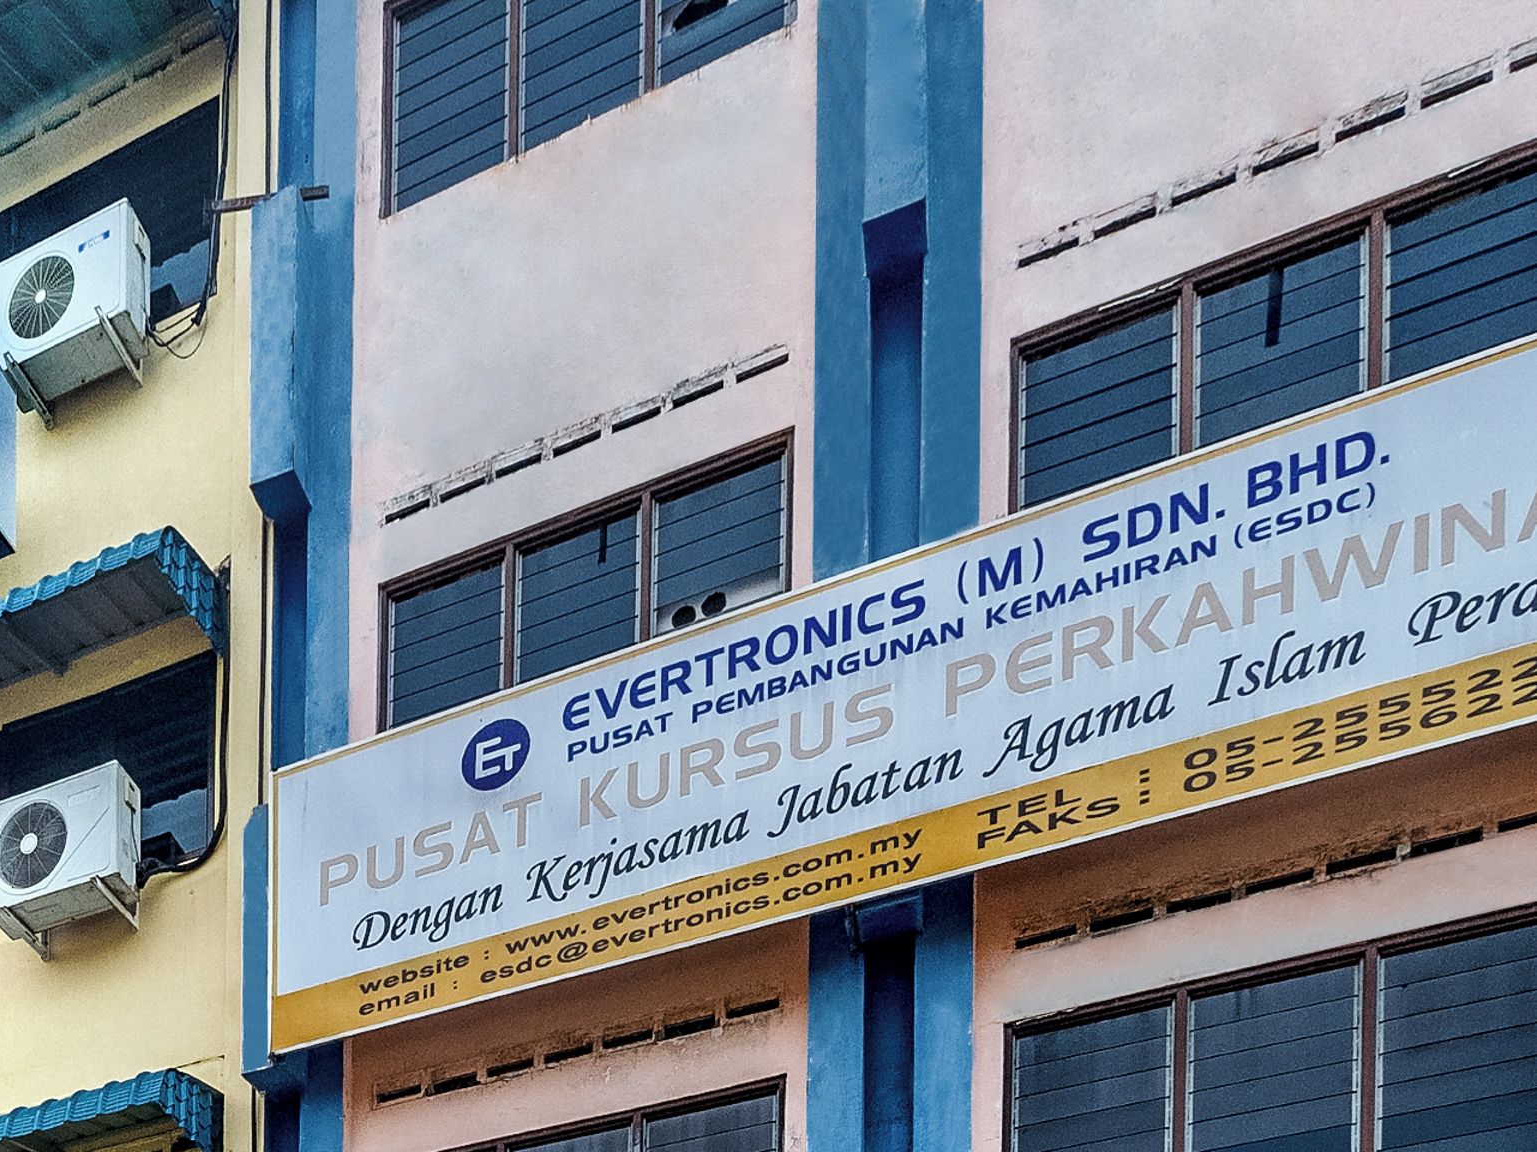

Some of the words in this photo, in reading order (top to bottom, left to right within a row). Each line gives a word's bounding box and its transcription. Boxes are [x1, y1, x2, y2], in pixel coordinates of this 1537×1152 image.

[563, 580, 926, 732] EVERTRONICS
[957, 538, 1045, 605] (M)
[1082, 483, 1226, 563] SDN.
[1246, 431, 1391, 508] BHD.
[567, 711, 675, 762] PUSAT
[691, 618, 964, 724] PEMBANGUNAN
[985, 535, 1218, 626] KEMAHIRAN
[1234, 481, 1376, 551] (ESDC)
[319, 792, 543, 907] PUSAT
[579, 682, 894, 827] KURSUS
[352, 881, 504, 952] Dengan
[526, 809, 751, 901] Kerjasama
[766, 748, 964, 840] Jabatan
[982, 682, 1175, 779] Agama
[1207, 629, 1366, 708] Islam
[976, 788, 1083, 826] TEL
[977, 797, 1120, 851] FAKS
[358, 984, 436, 1017] email
[479, 851, 923, 986] esdc@evertronics.com.my
[359, 950, 471, 996] website
[505, 827, 924, 956] www.evertronics.com.my
